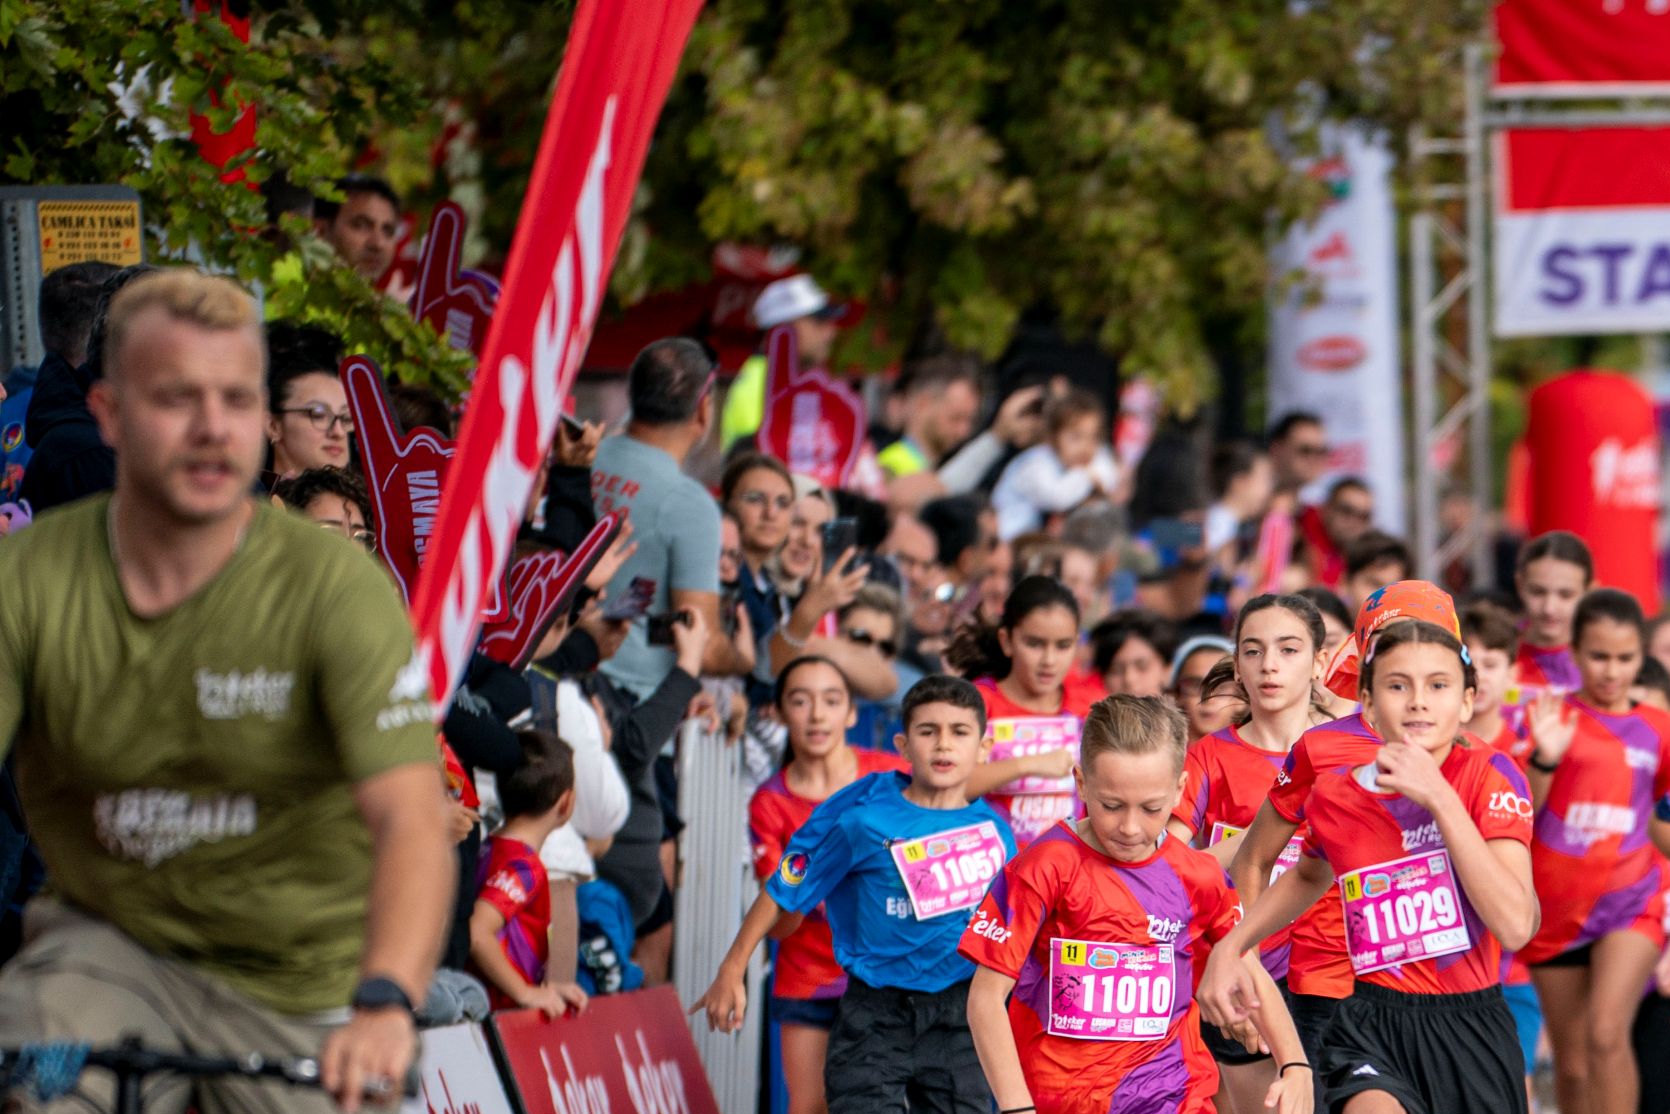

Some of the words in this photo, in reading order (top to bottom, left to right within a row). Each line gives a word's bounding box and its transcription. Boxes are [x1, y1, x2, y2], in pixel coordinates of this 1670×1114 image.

[1362, 886, 1458, 945] 11029
[1066, 944, 1078, 959] 11
[1081, 973, 1171, 1015] 11010
